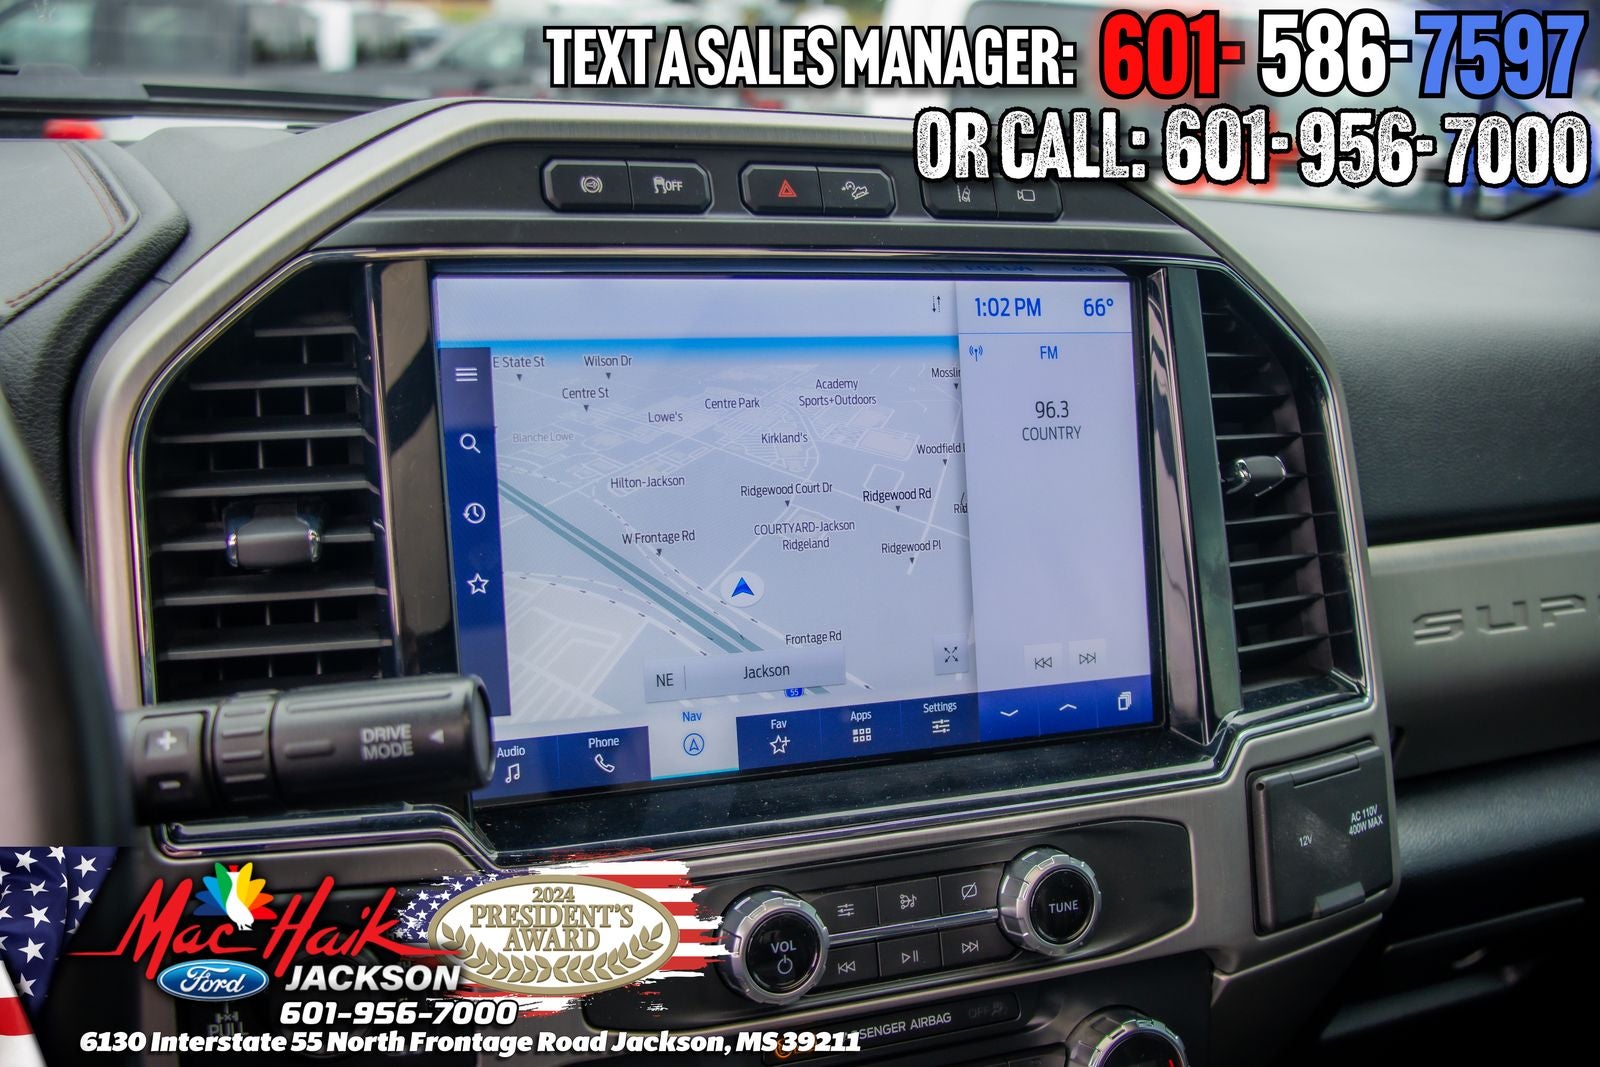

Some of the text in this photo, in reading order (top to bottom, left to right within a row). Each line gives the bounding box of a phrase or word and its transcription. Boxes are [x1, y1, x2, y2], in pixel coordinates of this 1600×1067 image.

[665, 179, 684, 193] OFF
[974, 297, 1042, 317] 1:02 PM
[1039, 345, 1059, 360] FM
[492, 355, 546, 369] E State St
[583, 355, 634, 368] Wilson Dr
[815, 378, 859, 391] Academy
[561, 387, 610, 400] Centre St
[798, 394, 877, 408] Sports+Outdoors
[704, 397, 761, 410] Centre Park
[1034, 400, 1069, 419] 96.3
[647, 410, 684, 423] Lowe's
[549, 431, 575, 442] Lowe
[761, 431, 809, 445] Kirkland's
[1021, 425, 1082, 441] COUNTRY
[916, 442, 962, 456] Woodfield
[609, 474, 686, 490] Hilton-Jackson
[740, 481, 833, 498] Ridgewood Court Dr
[862, 487, 932, 504] Ridgewood Rd
[753, 519, 856, 536] COURTYARD-Jackson
[622, 529, 696, 547] W Frontage Rd
[782, 537, 830, 552] Ridgeland
[881, 540, 931, 556] Ridgewood
[1412, 594, 1600, 645] SUP
[785, 630, 842, 648] Frontage Rd
[743, 663, 791, 680] Jackson
[655, 672, 674, 688] NE
[922, 700, 957, 715] Settings
[682, 710, 703, 723] Nav
[770, 717, 788, 730] Fav
[850, 709, 872, 723] Apps
[360, 724, 412, 743] DRIVE
[588, 736, 620, 749] Phone
[361, 740, 414, 761] MODE
[496, 744, 526, 758] Audio
[1350, 804, 1378, 823] AC 110V
[1348, 814, 1384, 836] 400W MAX
[1299, 834, 1313, 848] 12V
[1048, 899, 1080, 915] TUNE
[770, 940, 797, 955] VOL
[909, 1012, 952, 1031] AIRBAG
